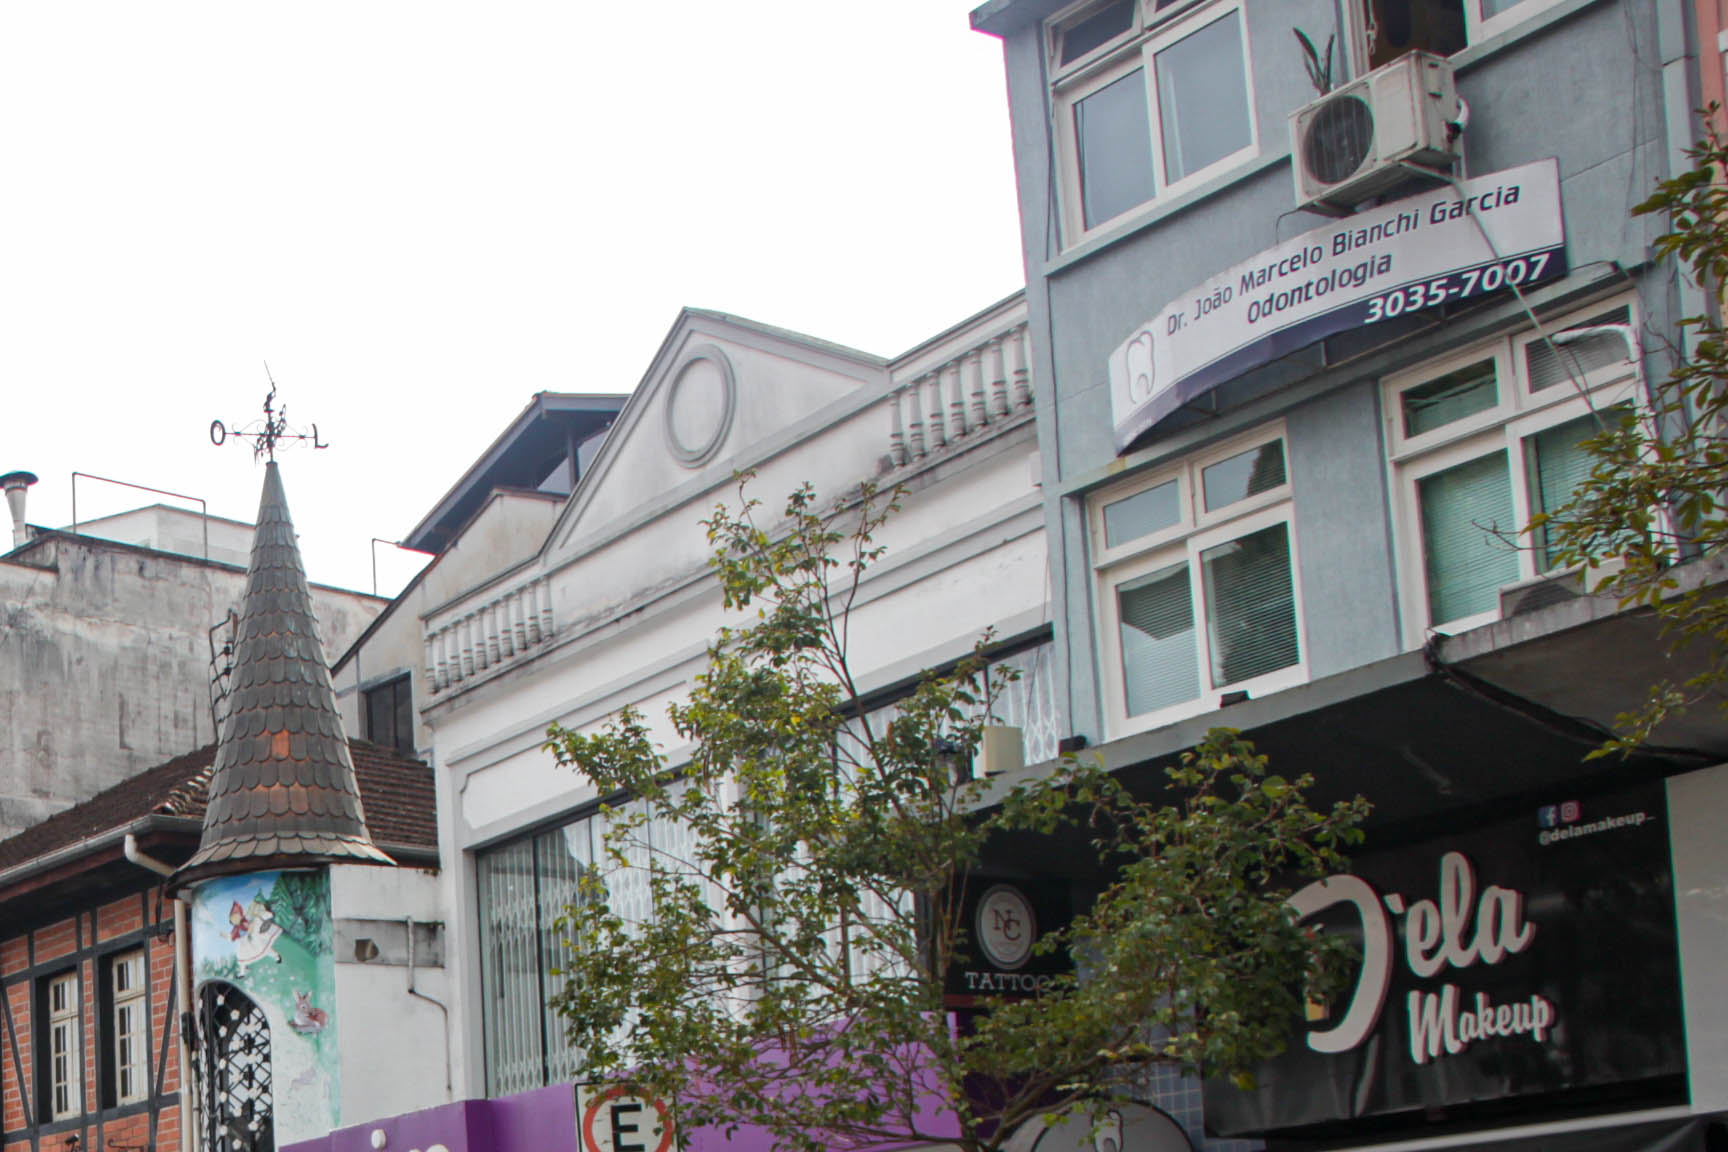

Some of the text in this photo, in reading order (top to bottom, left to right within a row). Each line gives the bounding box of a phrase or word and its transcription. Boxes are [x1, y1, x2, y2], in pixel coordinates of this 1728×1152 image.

[1167, 184, 1521, 336] Dr. João Marcelo Bianchi Garcia
[1247, 252, 1394, 324] Odontologia
[1363, 252, 1552, 324] 3035-7007
[1538, 811, 1656, 846] @delamakeup_
[1407, 984, 1555, 1065] Makeup
